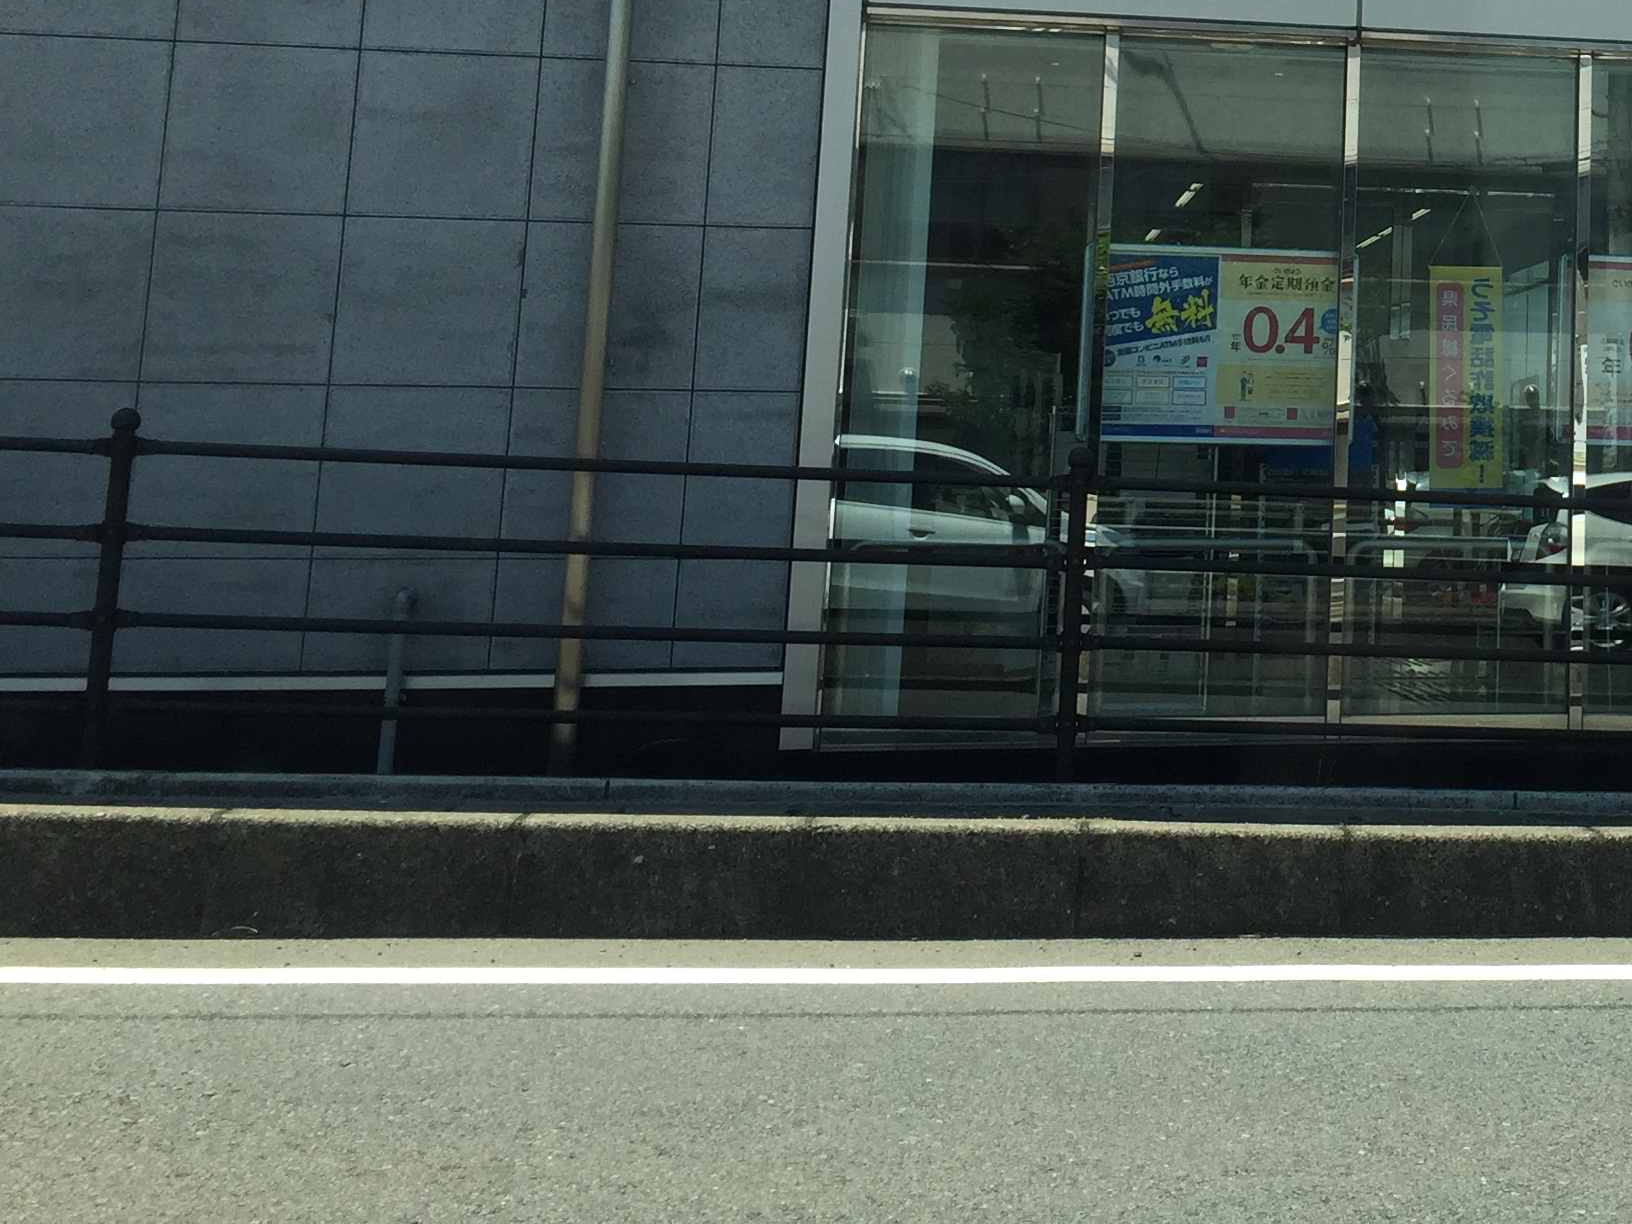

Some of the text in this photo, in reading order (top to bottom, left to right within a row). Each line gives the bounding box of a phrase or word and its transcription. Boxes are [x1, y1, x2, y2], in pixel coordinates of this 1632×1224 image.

[1238, 273, 1336, 293] 年金定期預金
[1145, 288, 1215, 334] 無料
[1230, 340, 1242, 352] 年
[1243, 306, 1321, 355] 0.4
[1601, 356, 1622, 378] 年
